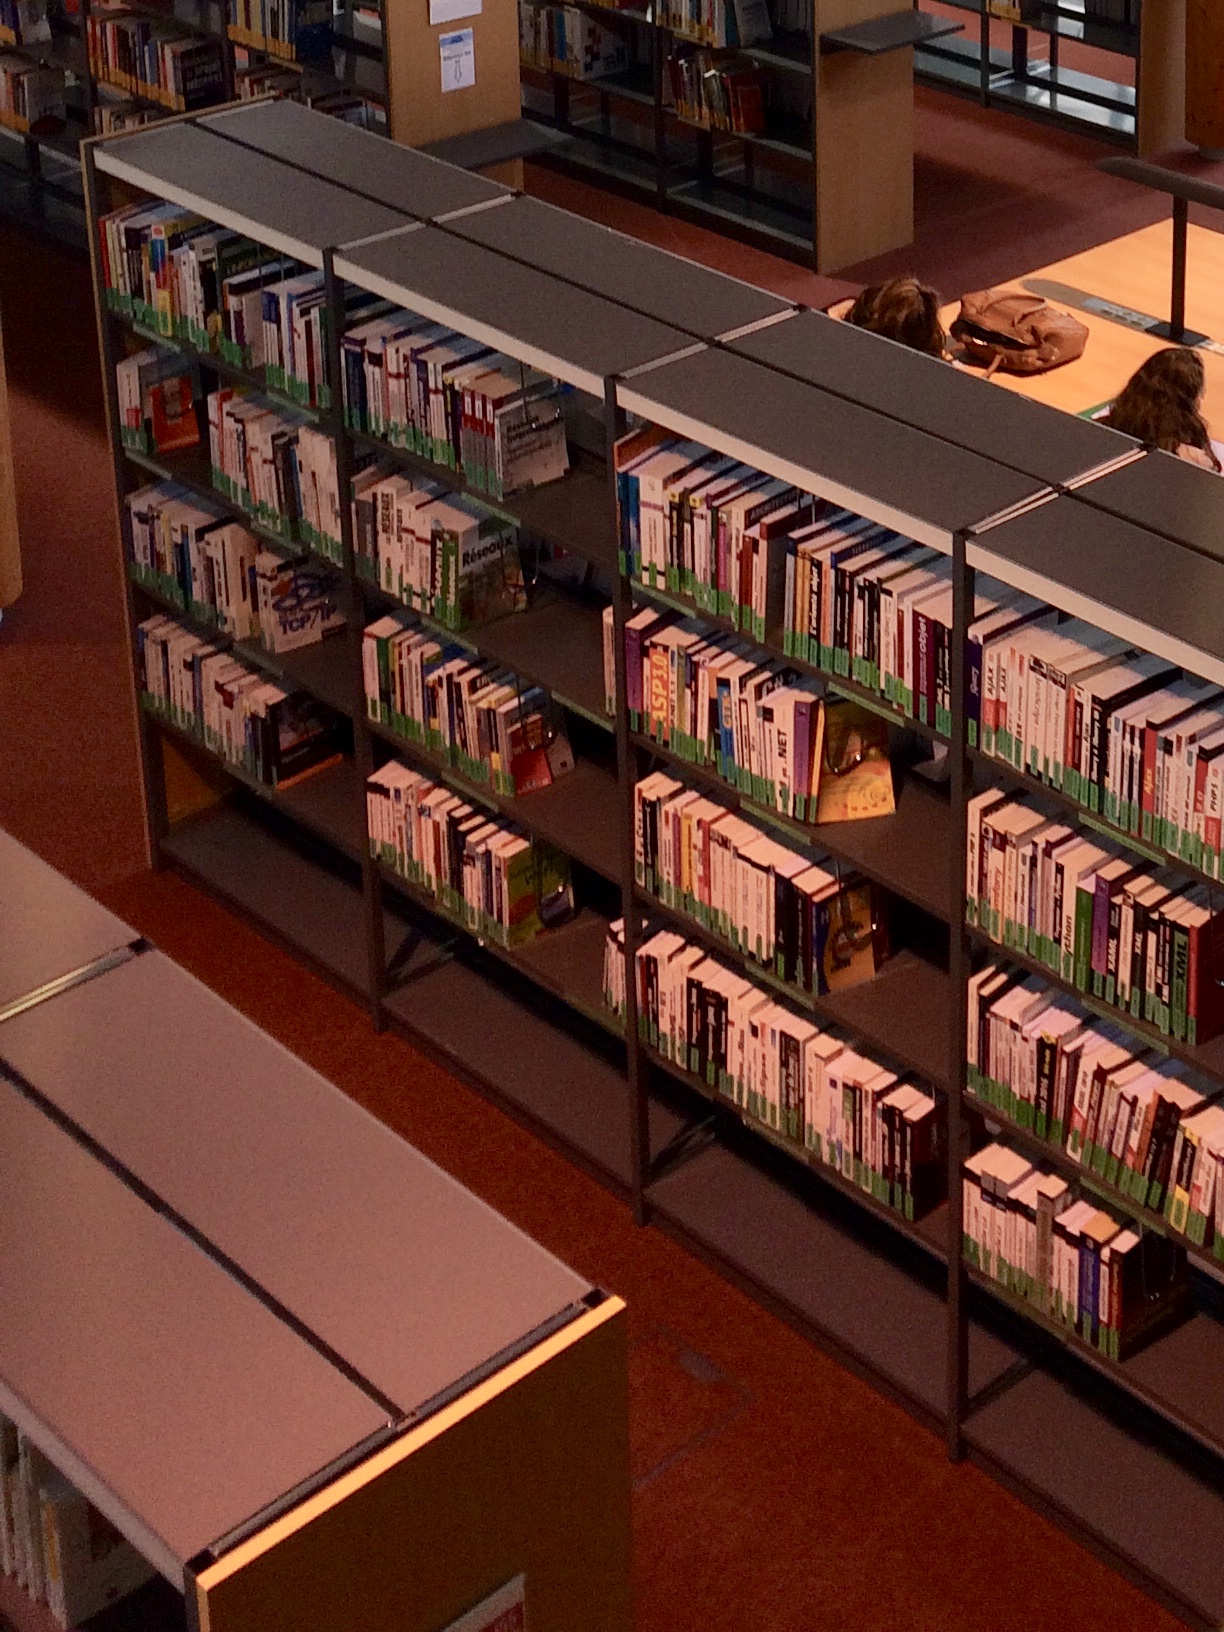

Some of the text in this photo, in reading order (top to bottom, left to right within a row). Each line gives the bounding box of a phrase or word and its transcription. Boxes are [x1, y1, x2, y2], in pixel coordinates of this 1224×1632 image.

[651, 680, 668, 722] ASP
[777, 728, 788, 765] .NET
[1175, 940, 1187, 982] XML
